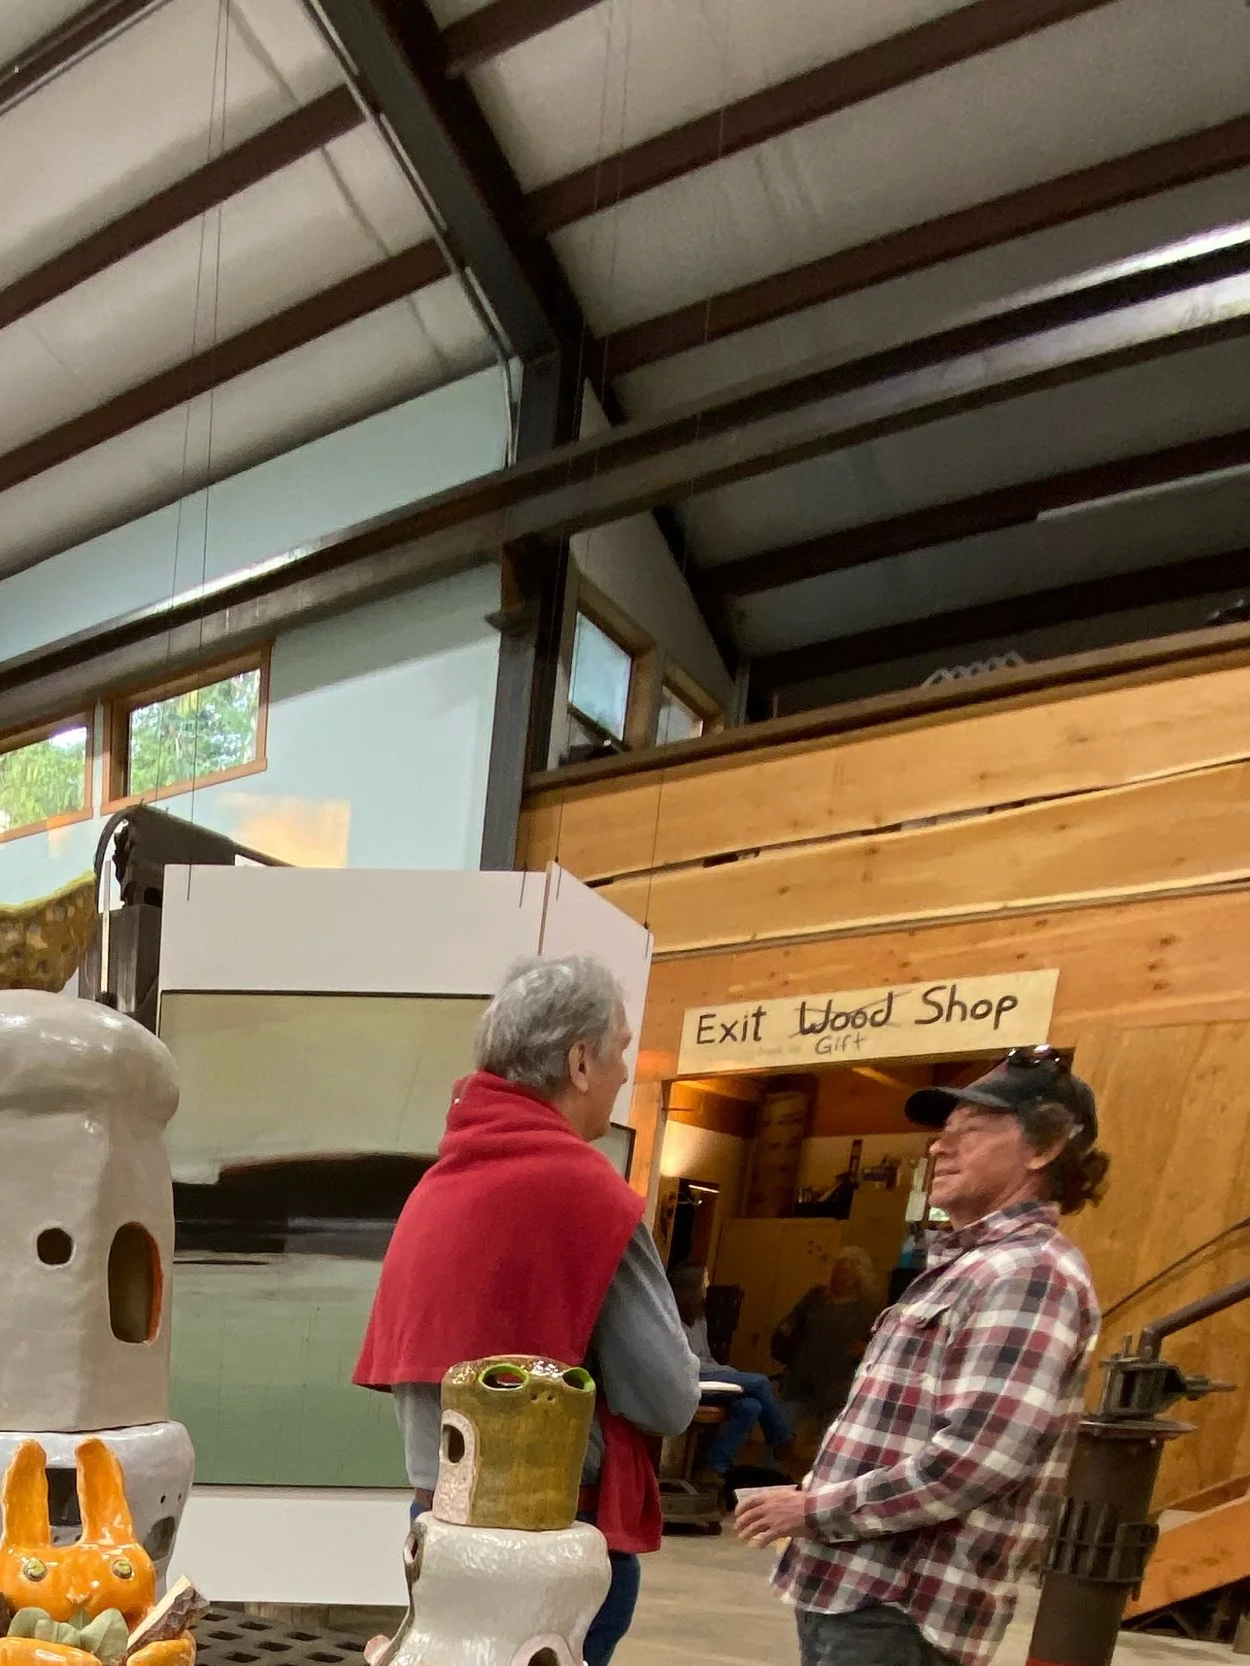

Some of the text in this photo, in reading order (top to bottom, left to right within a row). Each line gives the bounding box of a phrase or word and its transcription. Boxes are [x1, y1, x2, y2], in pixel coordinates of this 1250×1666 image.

[696, 984, 1018, 1045] Exit Wood Shop
